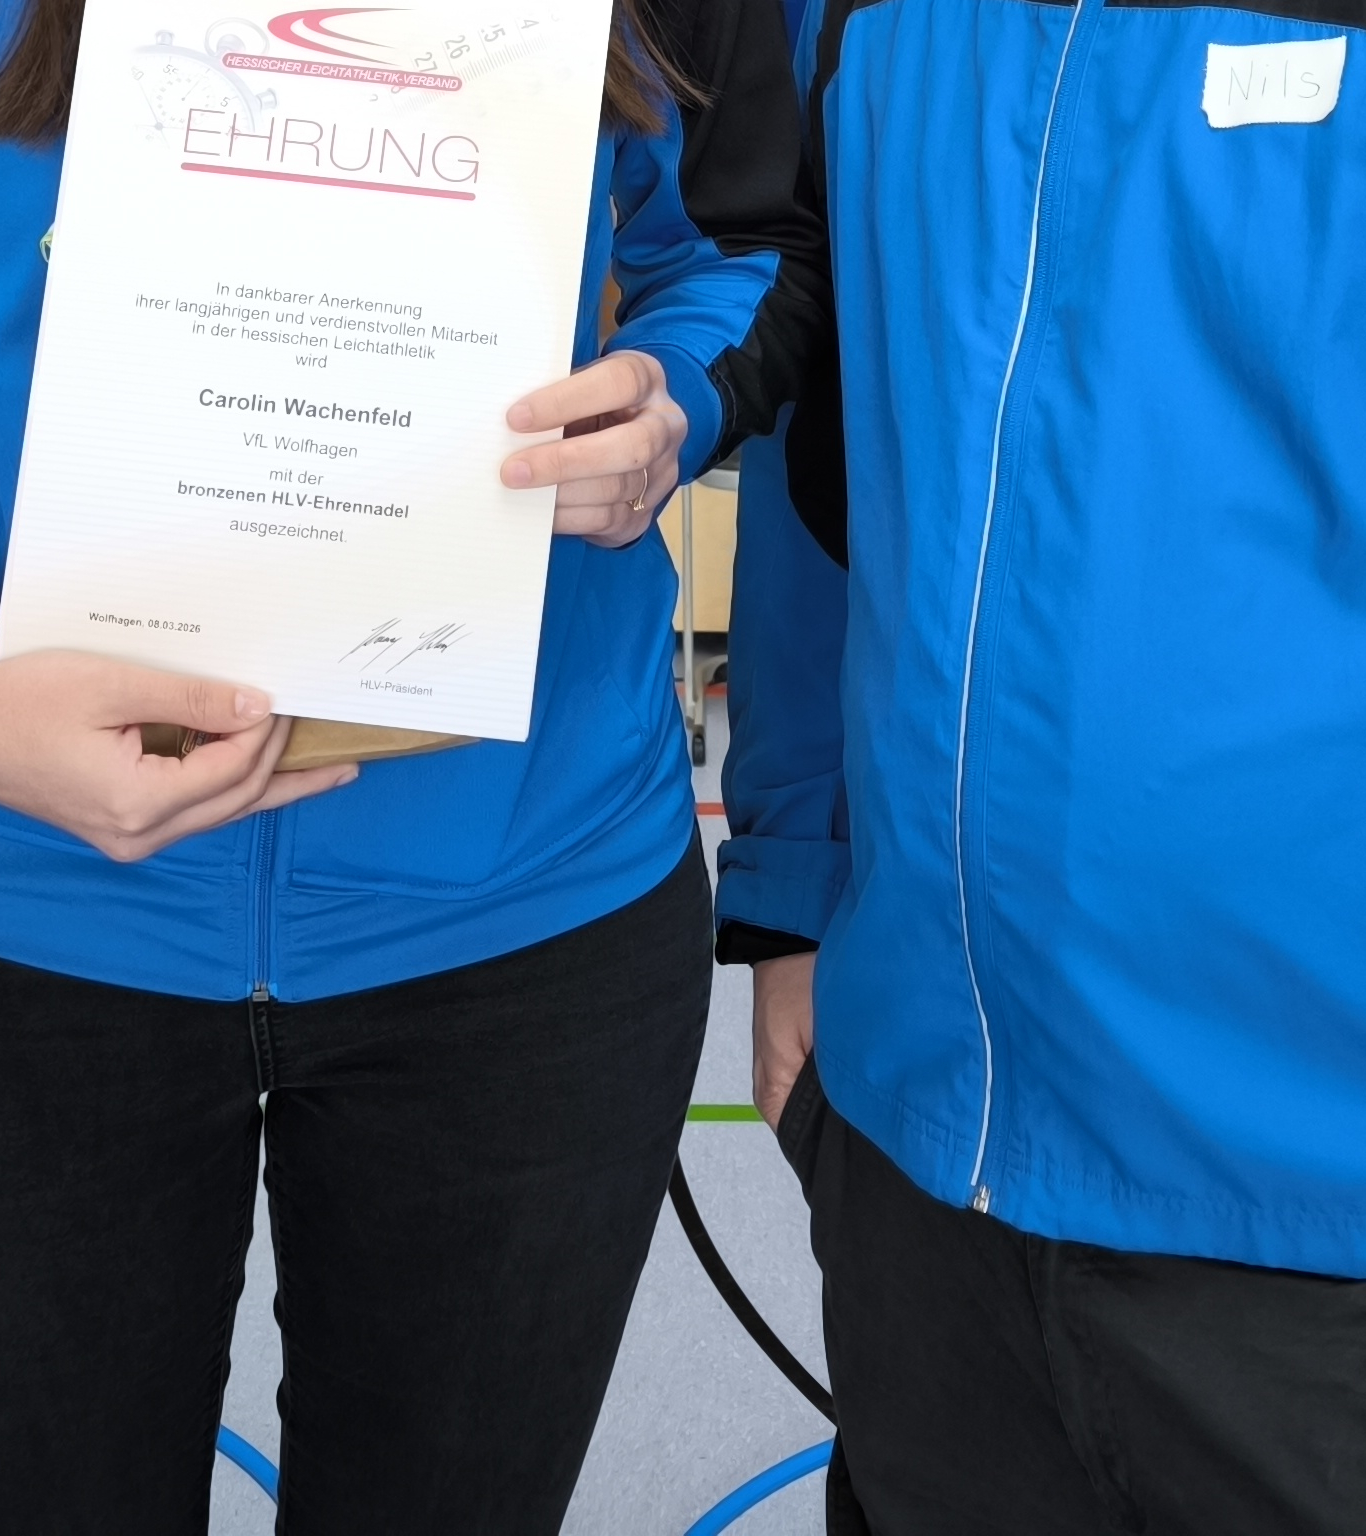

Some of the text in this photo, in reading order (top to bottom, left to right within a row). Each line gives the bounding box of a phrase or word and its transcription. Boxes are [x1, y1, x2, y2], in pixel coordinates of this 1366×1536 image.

[225, 55, 302, 74] HESSISCHER
[303, 64, 460, 90] LEICHTATHLETIK-VERBAND
[1227, 59, 1321, 106] Nils
[182, 108, 480, 184] EHRUNG
[135, 293, 498, 346] ihrer langjährigen und verdienstvollen Mitarbeit
[216, 281, 423, 321] In dankbarer Anerkennung
[191, 320, 436, 360] in der hessischen Leichtathletik
[295, 353, 328, 369] wird
[199, 388, 412, 428] Carolin Wachenfeld
[243, 432, 358, 460] VfL Wolfhagen
[269, 468, 325, 486] mit der
[177, 479, 410, 519] bronzenen HLV-Ehrennadel
[229, 520, 348, 543] ausgezeichnet.
[88, 611, 202, 634] Wolfhagen, 08.03.2026
[360, 679, 433, 697] HLV-Präsident
